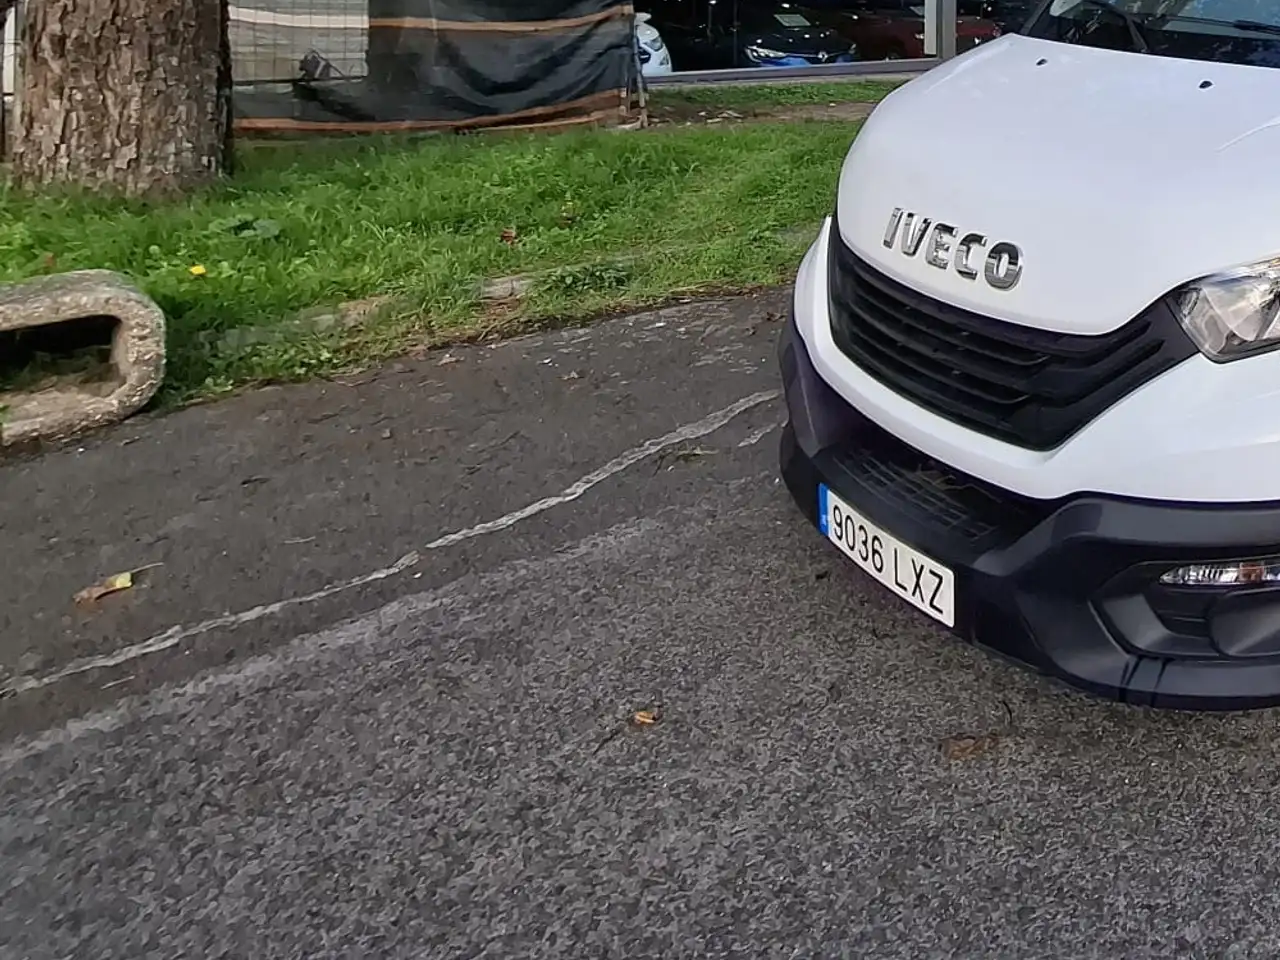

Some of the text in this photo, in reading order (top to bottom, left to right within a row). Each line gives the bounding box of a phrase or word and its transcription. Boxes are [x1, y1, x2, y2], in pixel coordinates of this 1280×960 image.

[883, 207, 1024, 290] IVECO
[833, 504, 944, 615] 9036 LXZ
